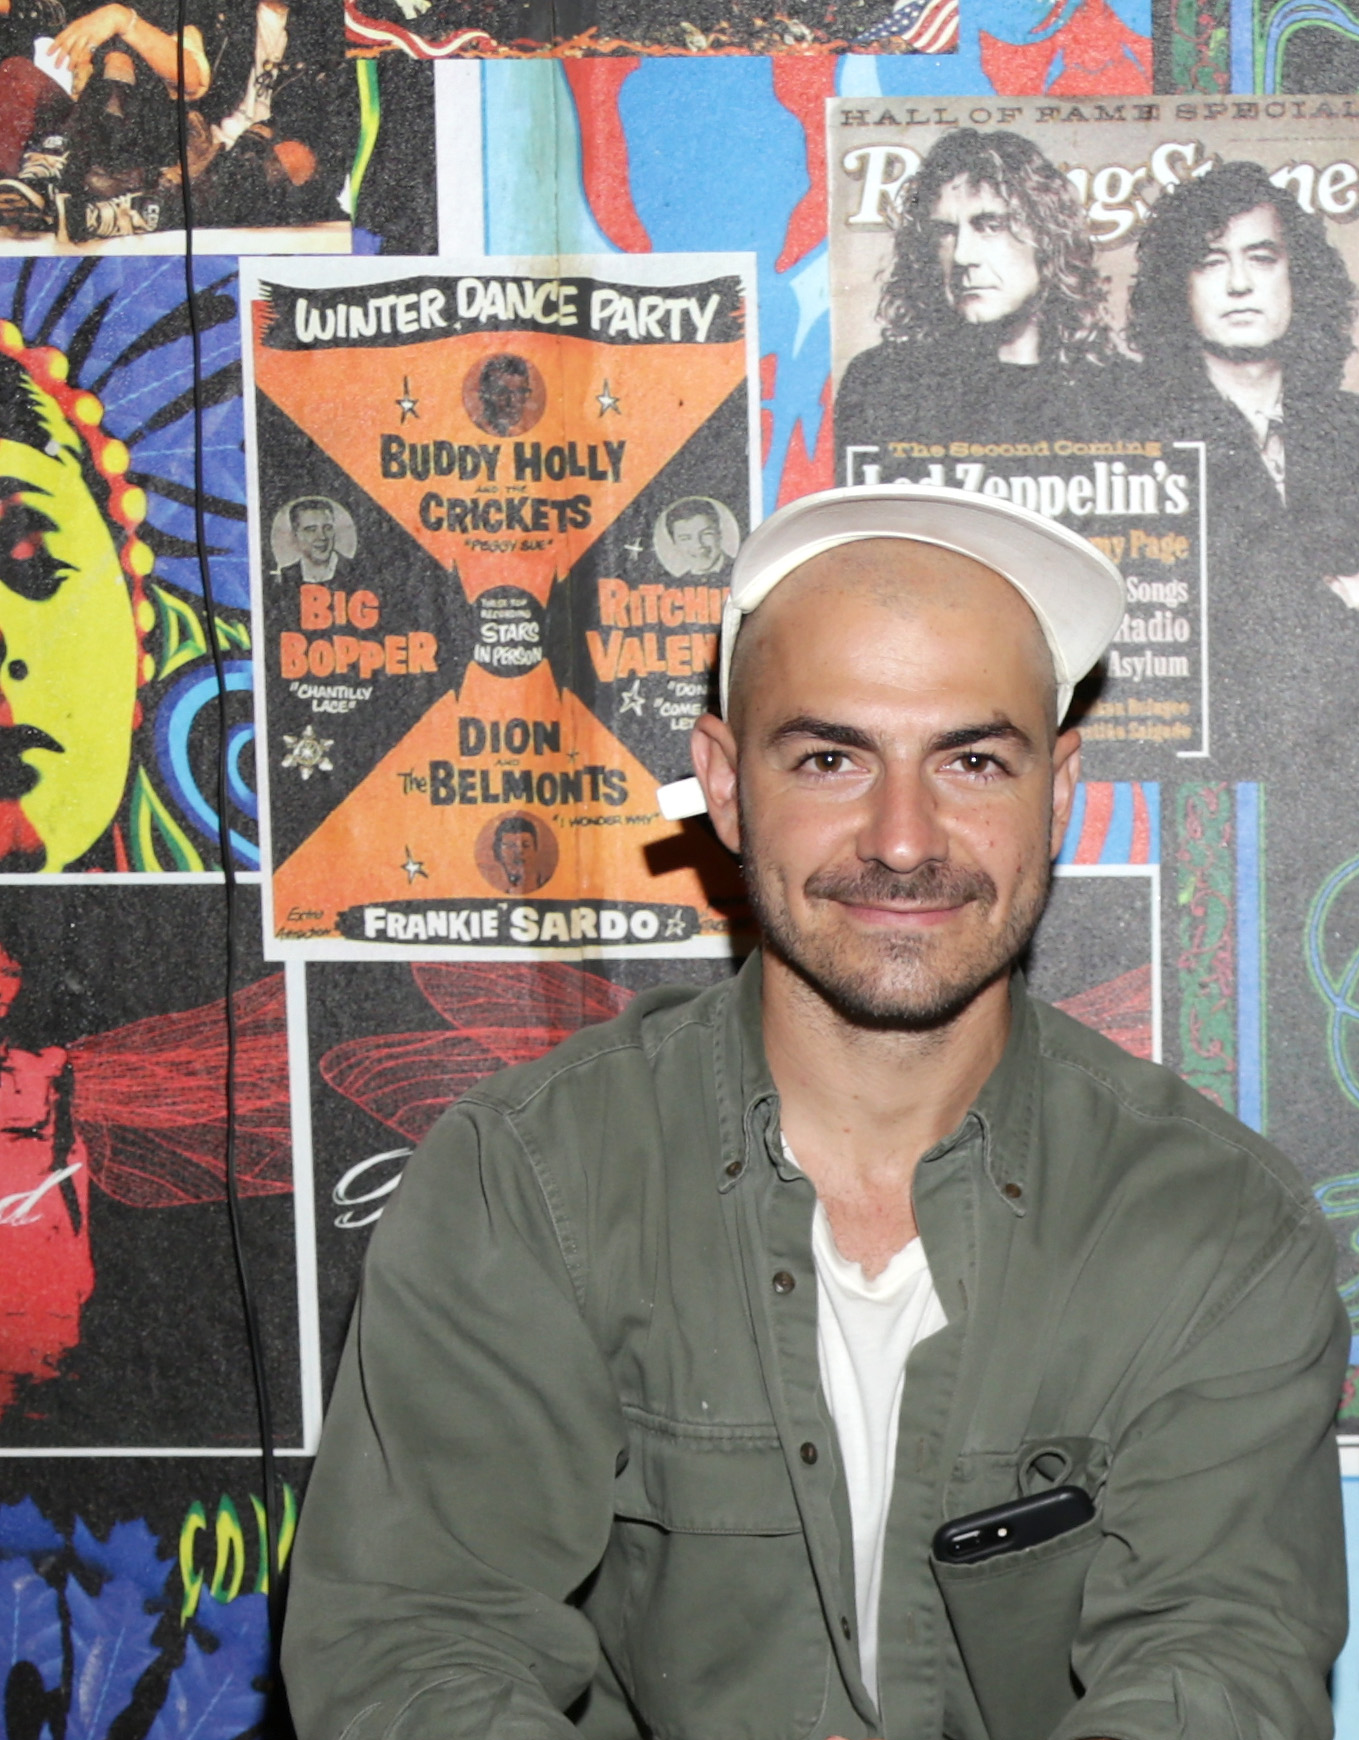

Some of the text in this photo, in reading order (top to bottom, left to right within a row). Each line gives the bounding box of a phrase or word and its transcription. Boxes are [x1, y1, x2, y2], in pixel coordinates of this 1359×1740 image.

[840, 102, 960, 127] HALL
[962, 102, 1024, 125] OF
[1036, 102, 1160, 124] FAME
[294, 277, 719, 343] WINTER DANCE PARTY
[380, 433, 627, 483] BUDDY HOLLY
[887, 439, 1163, 458] The Second Coming
[419, 493, 592, 534] CRICKETS
[1129, 529, 1190, 565] Page
[299, 583, 380, 629] BIG
[1126, 575, 1189, 608] Songs
[480, 621, 540, 643] STARS
[1111, 610, 1190, 643] Radio
[280, 631, 438, 680] BOPPER
[473, 643, 543, 667] IN PERSON
[1107, 650, 1190, 683] Asylum
[458, 717, 561, 758] DION
[397, 760, 629, 807] The BELMONTS
[364, 906, 498, 942] FRANKIE
[510, 906, 660, 943] SARDO
